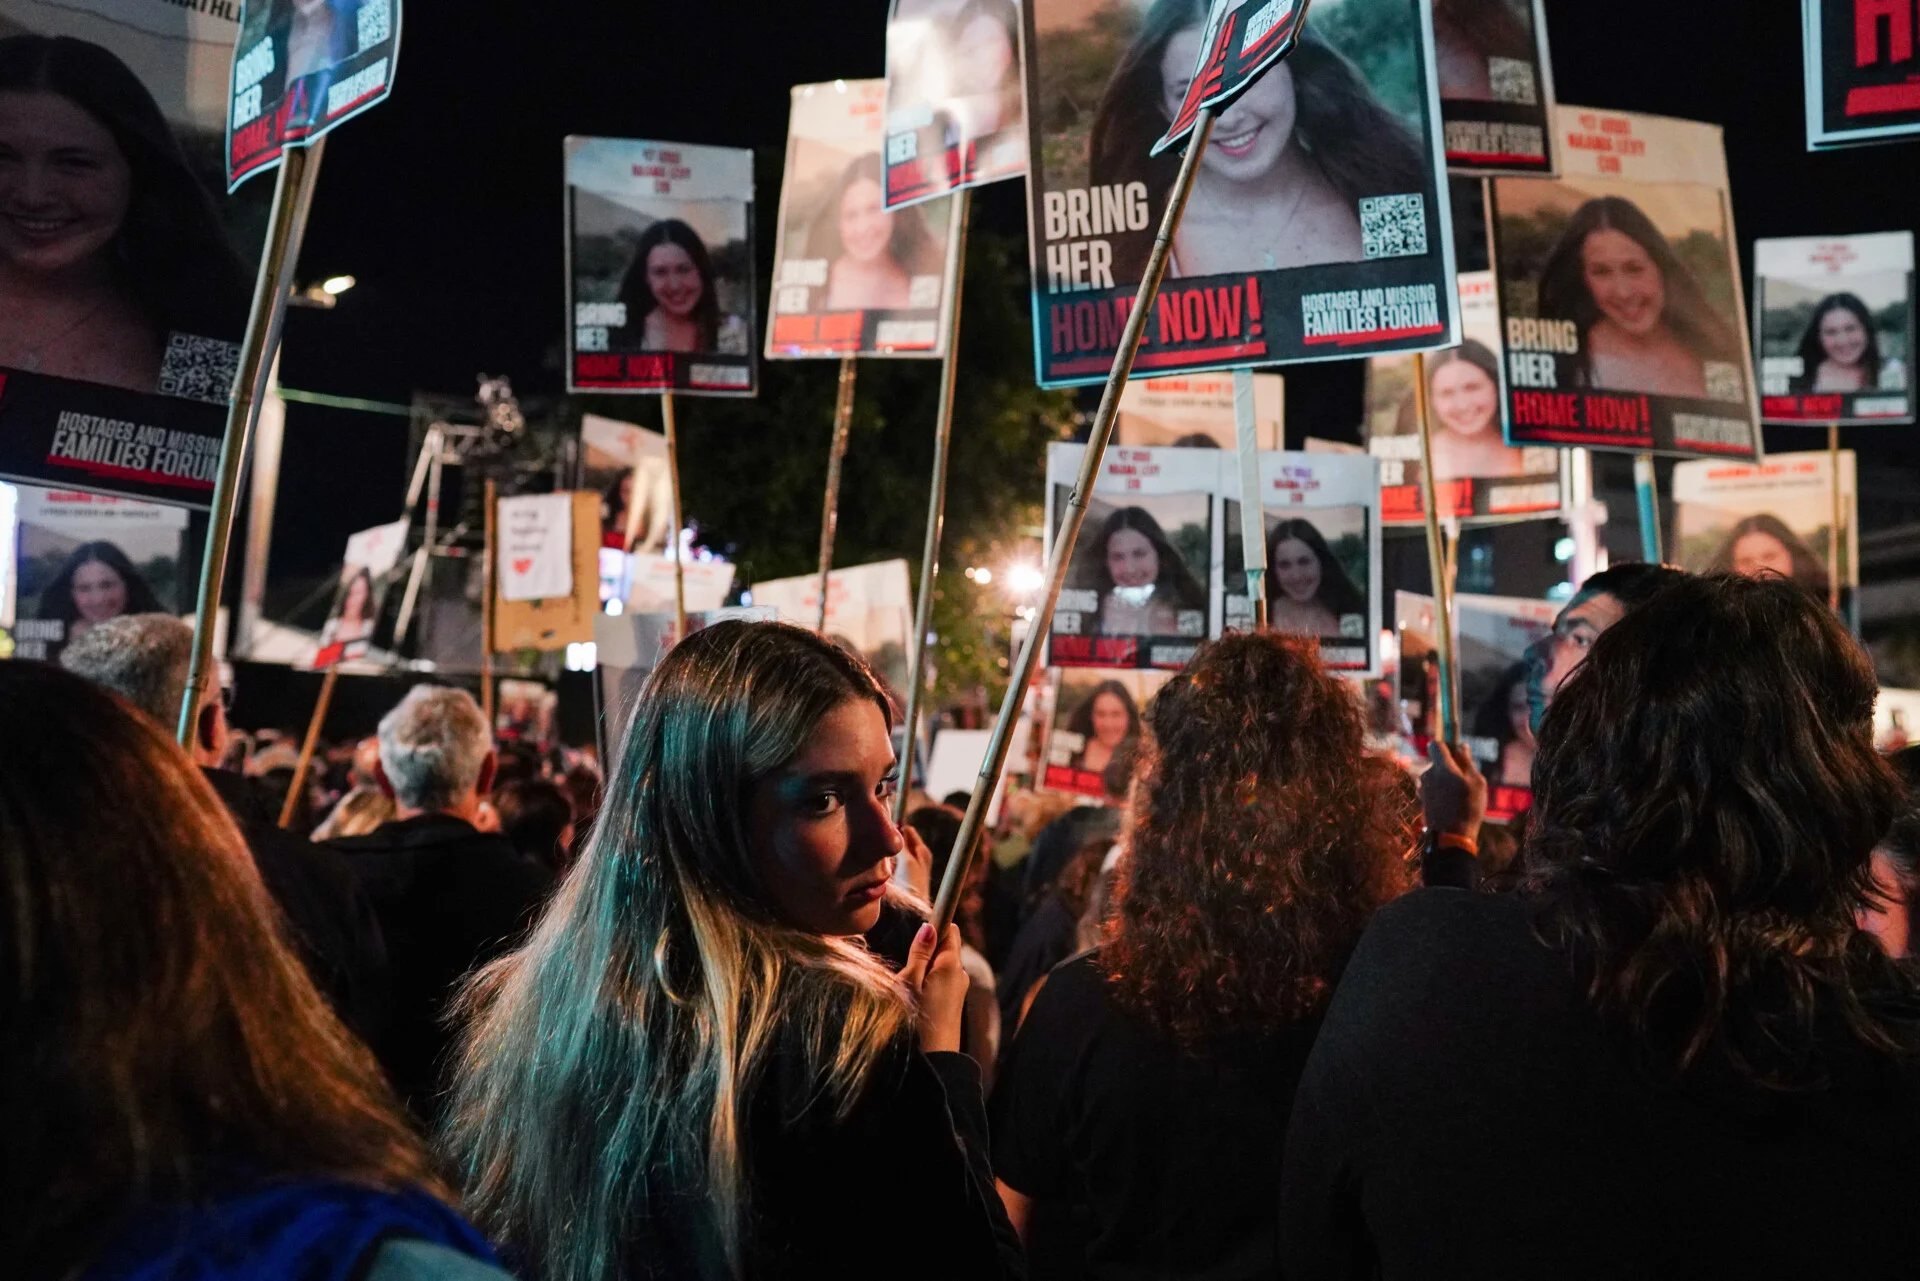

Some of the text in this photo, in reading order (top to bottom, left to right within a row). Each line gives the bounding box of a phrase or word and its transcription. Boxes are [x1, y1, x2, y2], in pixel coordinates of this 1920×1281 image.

[1853, 0, 1920, 68] H
[1043, 182, 1149, 240] BRING
[1046, 240, 1115, 294] HER
[1050, 277, 1263, 353] HOM NOW!
[1301, 283, 1437, 312] HOSTAGES AND MISSING
[1303, 300, 1440, 338] FAMILIES FORUM
[1507, 316, 1579, 354] BRING
[1509, 352, 1557, 388] HER
[1512, 391, 1579, 428] HOME
[1585, 394, 1652, 432] NOW!
[50, 431, 150, 471] FAMILIES
[56, 410, 224, 457] HOSTAGES AND MISSIN
